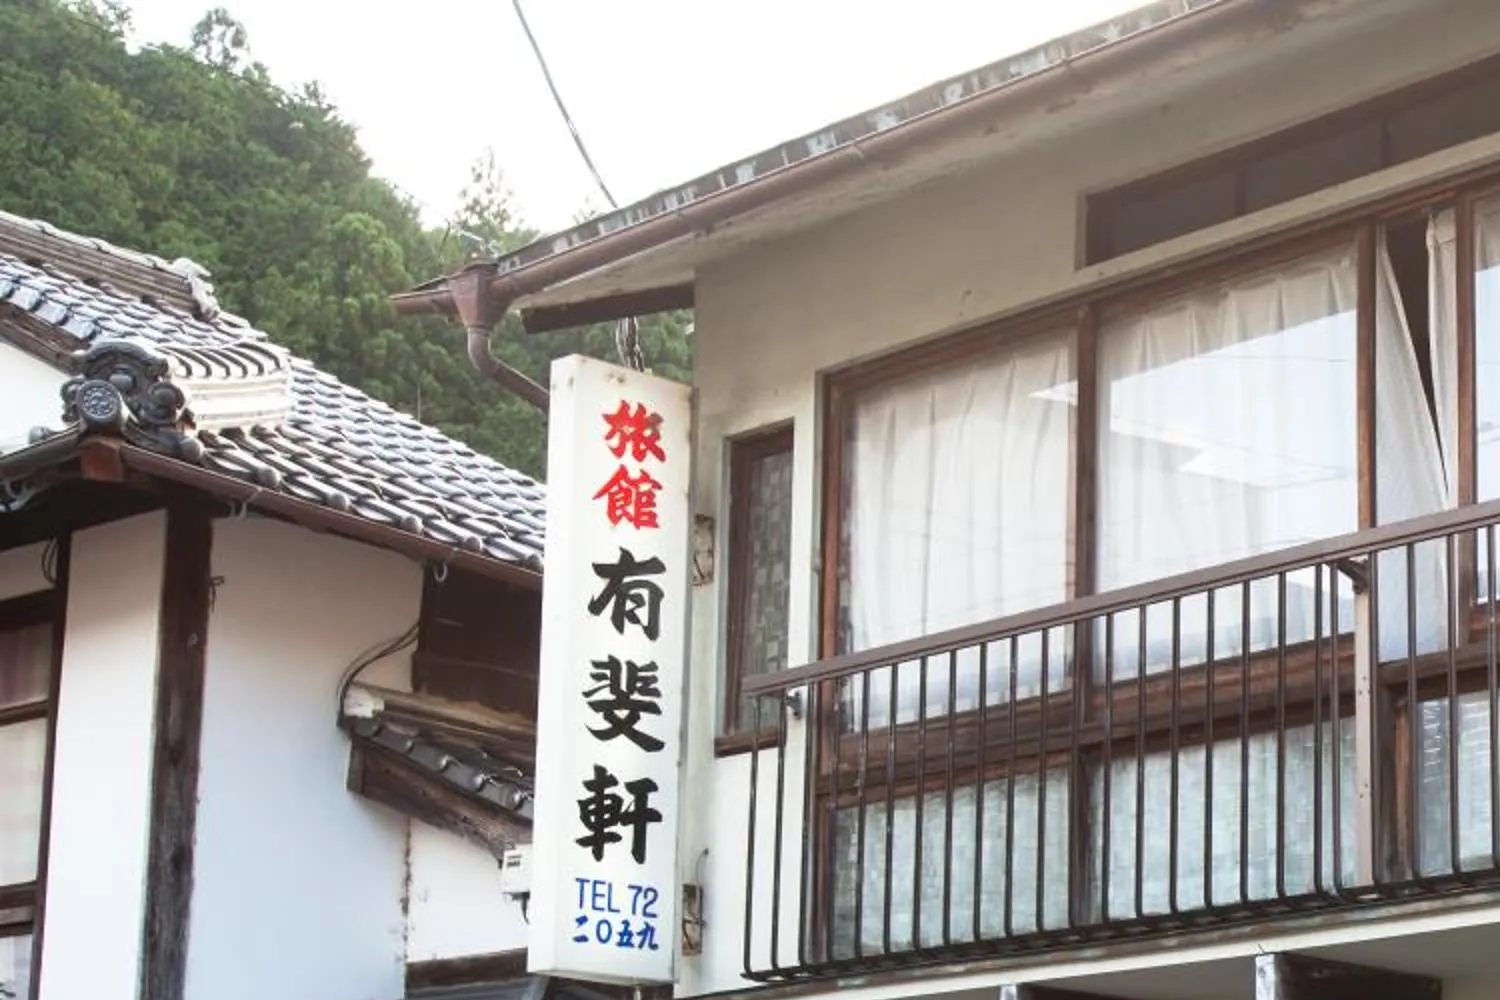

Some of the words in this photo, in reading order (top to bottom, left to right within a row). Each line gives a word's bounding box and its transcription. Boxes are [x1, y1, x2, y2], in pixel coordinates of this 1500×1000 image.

[592, 399, 666, 530] 旅館
[576, 546, 667, 865] 有斐軒
[575, 877, 621, 913] TEL
[627, 884, 659, 918] 72
